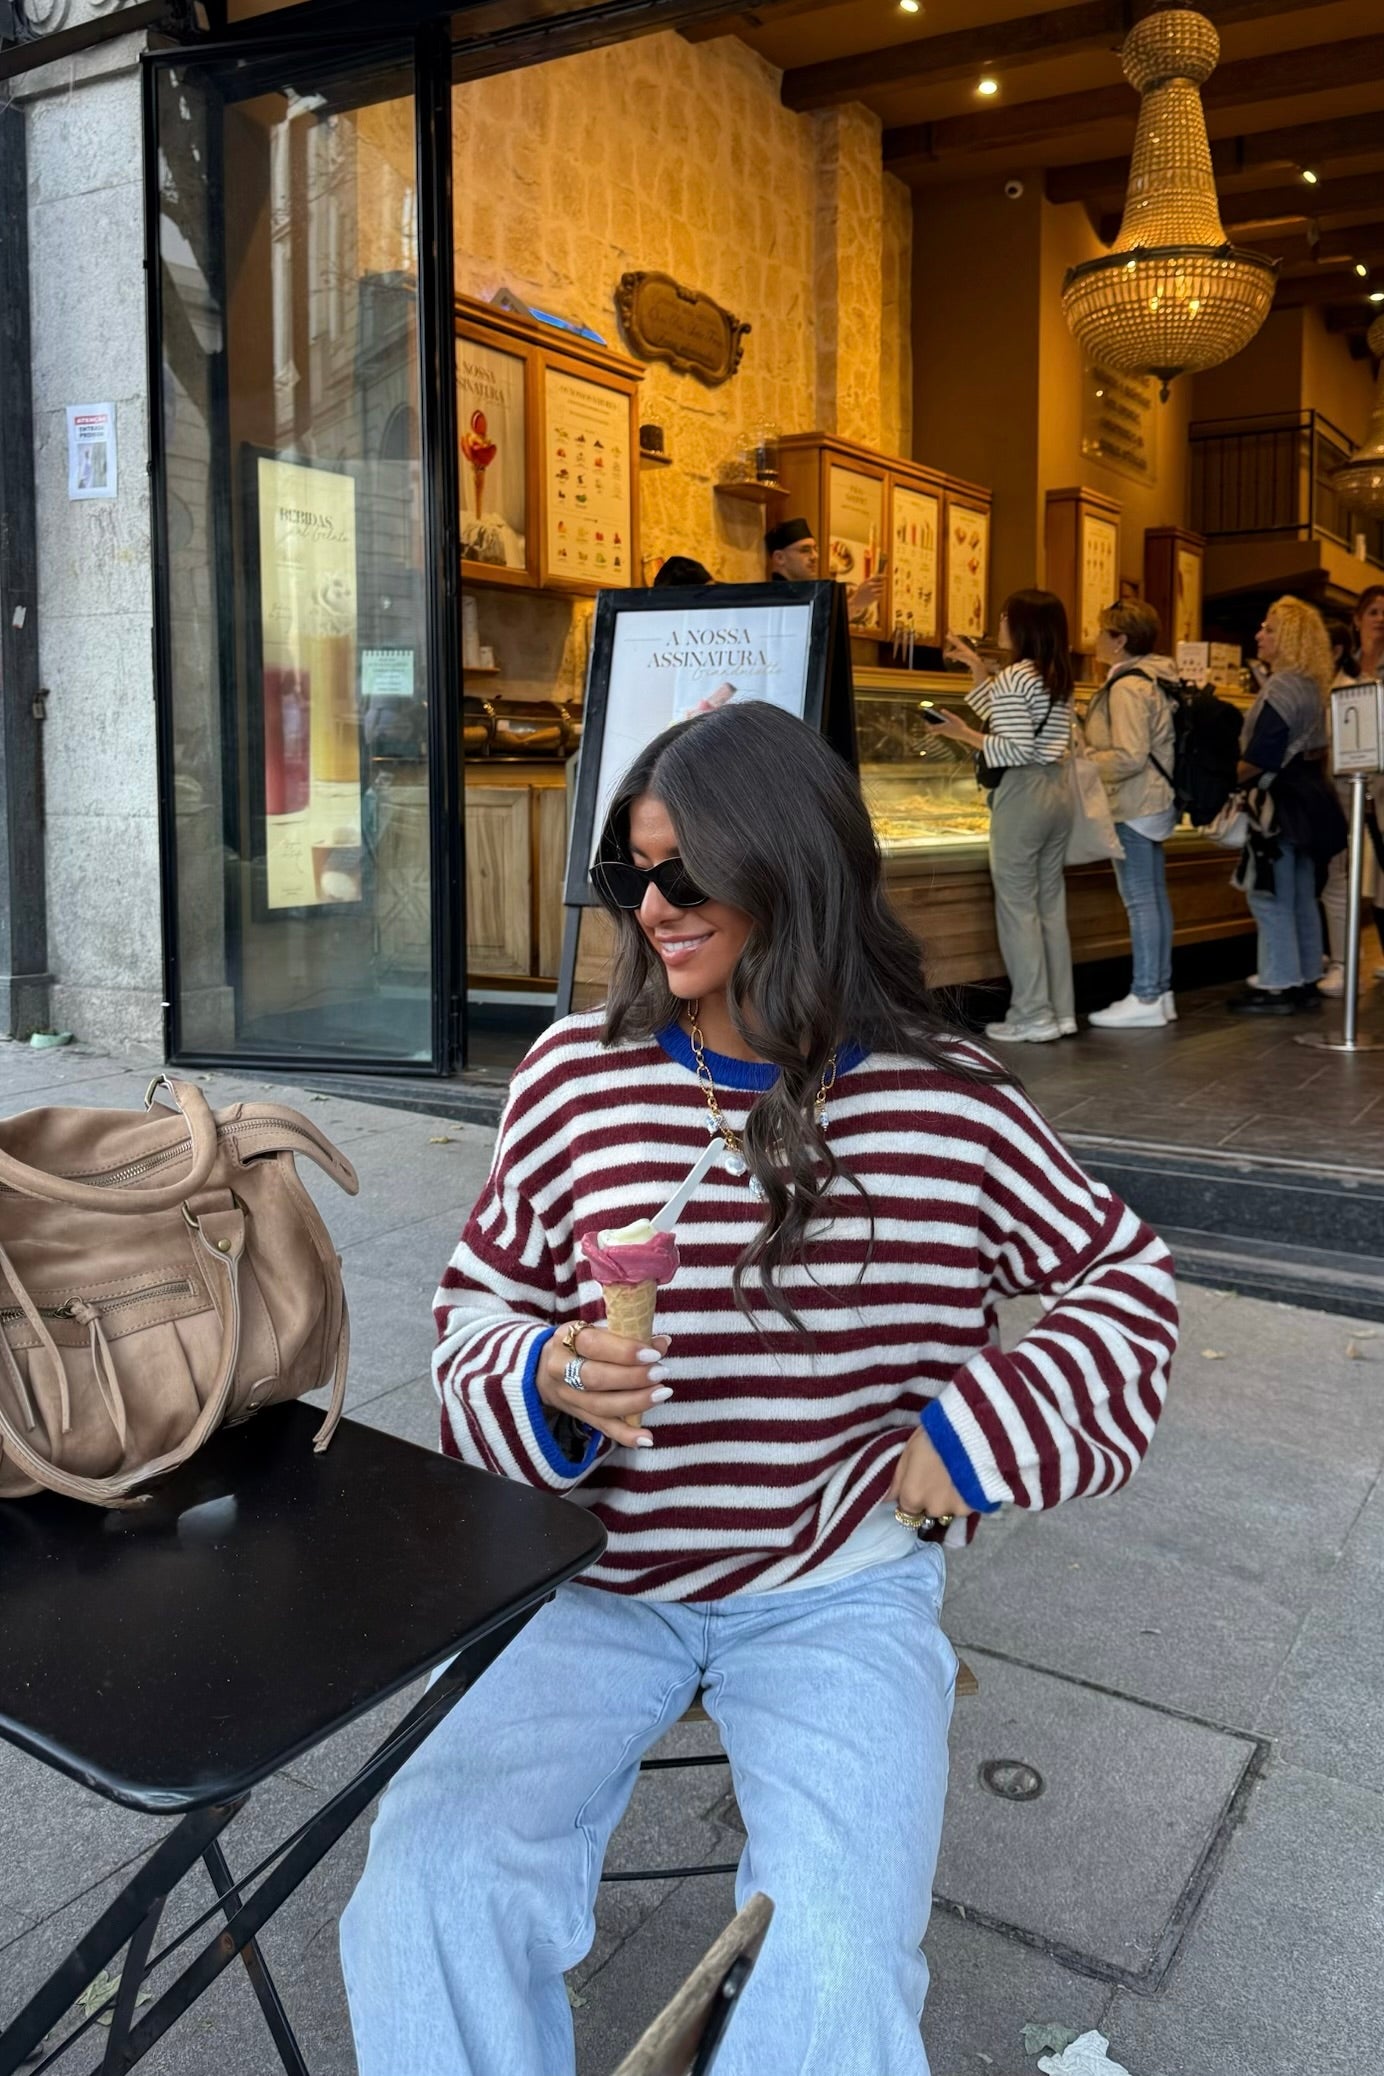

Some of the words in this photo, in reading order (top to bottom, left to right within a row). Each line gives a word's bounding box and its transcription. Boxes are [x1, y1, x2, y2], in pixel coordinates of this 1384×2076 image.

[280, 507, 333, 528] BEBIDAS
[666, 630, 679, 646] A
[685, 628, 751, 646] NOSSA
[647, 649, 767, 668] ASSINATURA
